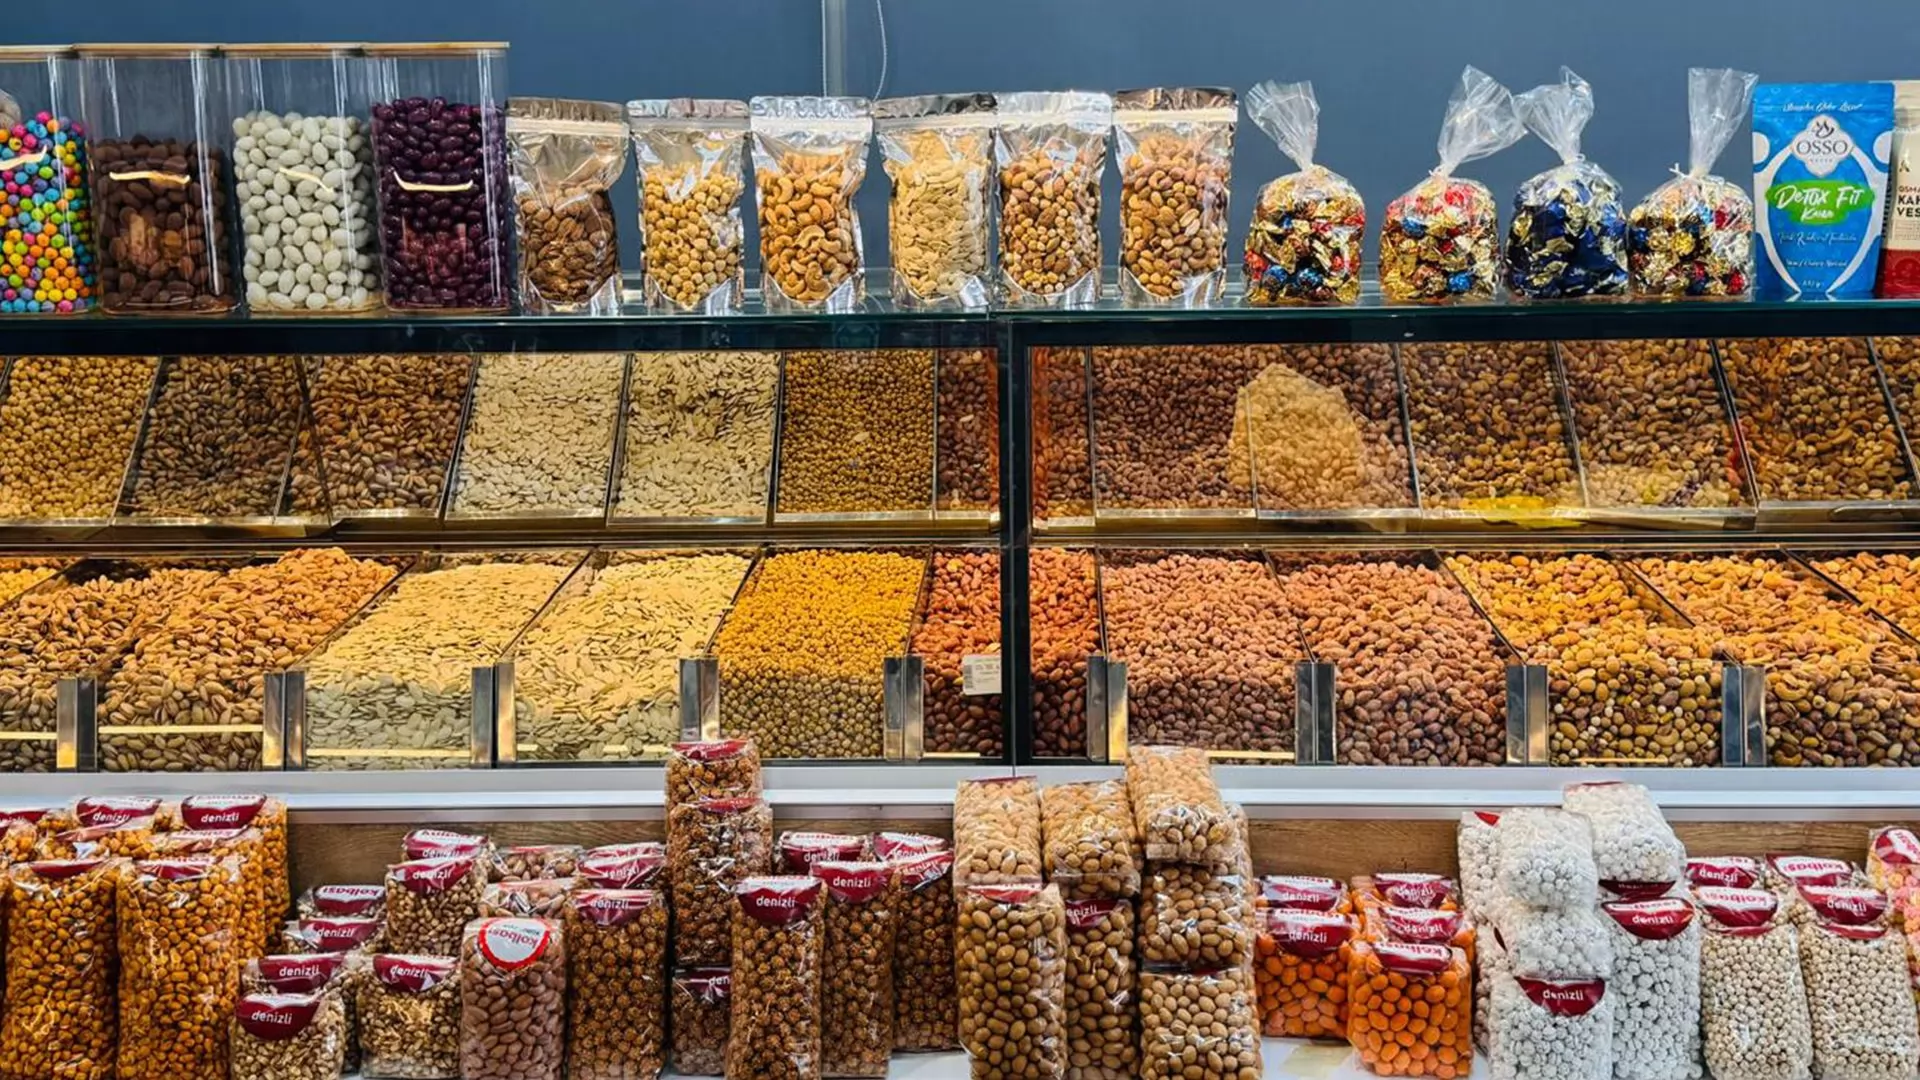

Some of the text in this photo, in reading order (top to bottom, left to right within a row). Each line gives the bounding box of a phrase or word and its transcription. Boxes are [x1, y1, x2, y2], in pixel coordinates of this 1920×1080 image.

[1796, 139, 1848, 155] OSSO
[92, 811, 132, 822] denizli
[201, 812, 239, 823] denizli
[833, 876, 872, 888] denizli
[1699, 870, 1739, 883] denizli
[756, 895, 796, 908] denizli
[1282, 891, 1320, 903] denizli
[1632, 915, 1674, 924] denizli
[316, 926, 355, 938] denizli
[1288, 930, 1328, 943] denizli
[279, 965, 320, 977] denizli
[1542, 988, 1584, 1001] denizli
[251, 1010, 293, 1025] denizli
